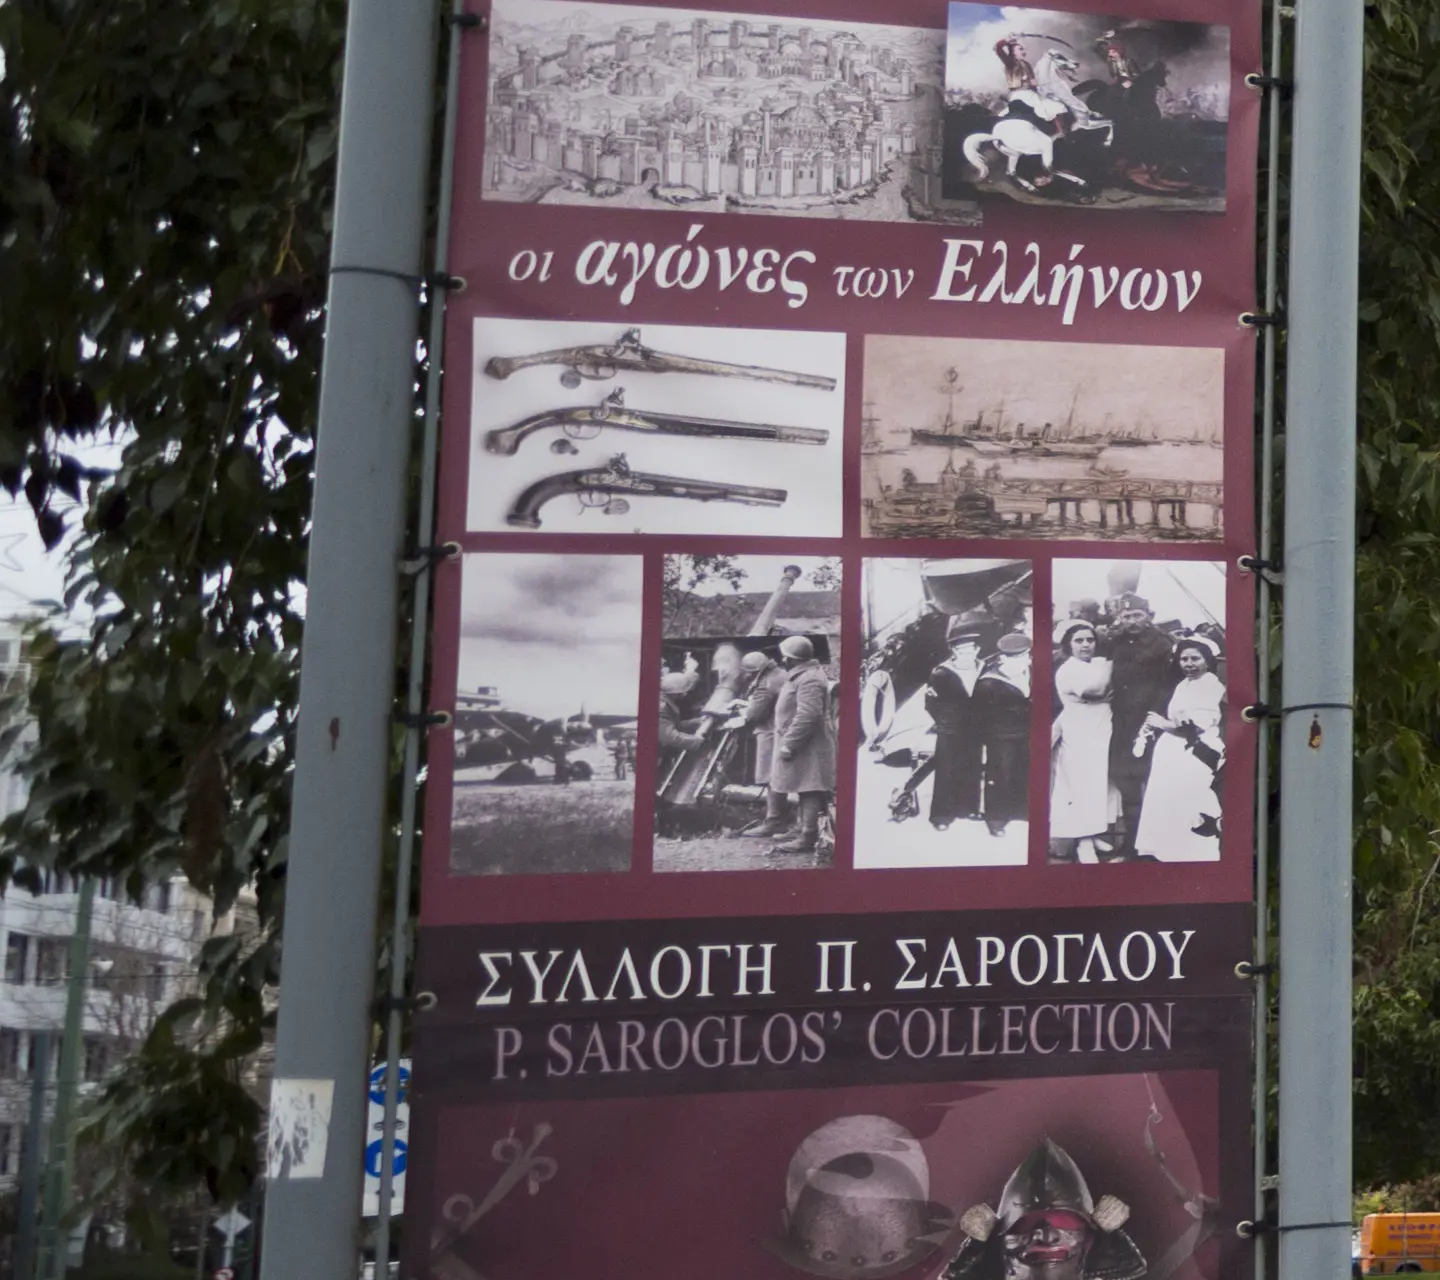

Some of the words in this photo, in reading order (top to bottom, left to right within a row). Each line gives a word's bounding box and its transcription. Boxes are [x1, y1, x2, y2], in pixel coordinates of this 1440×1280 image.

[508, 248, 552, 286] οι
[574, 225, 816, 308] αγώνες
[832, 264, 914, 300] των
[930, 236, 1203, 325] Ελλήνων
[475, 942, 776, 1007] ΣΥΛΛΟΓΗ
[815, 940, 872, 994] Π.
[893, 929, 1196, 991] ΣΑΡΟΓΛΟΥ
[492, 1026, 528, 1080] P.
[867, 1002, 1177, 1060] COLLECTION
